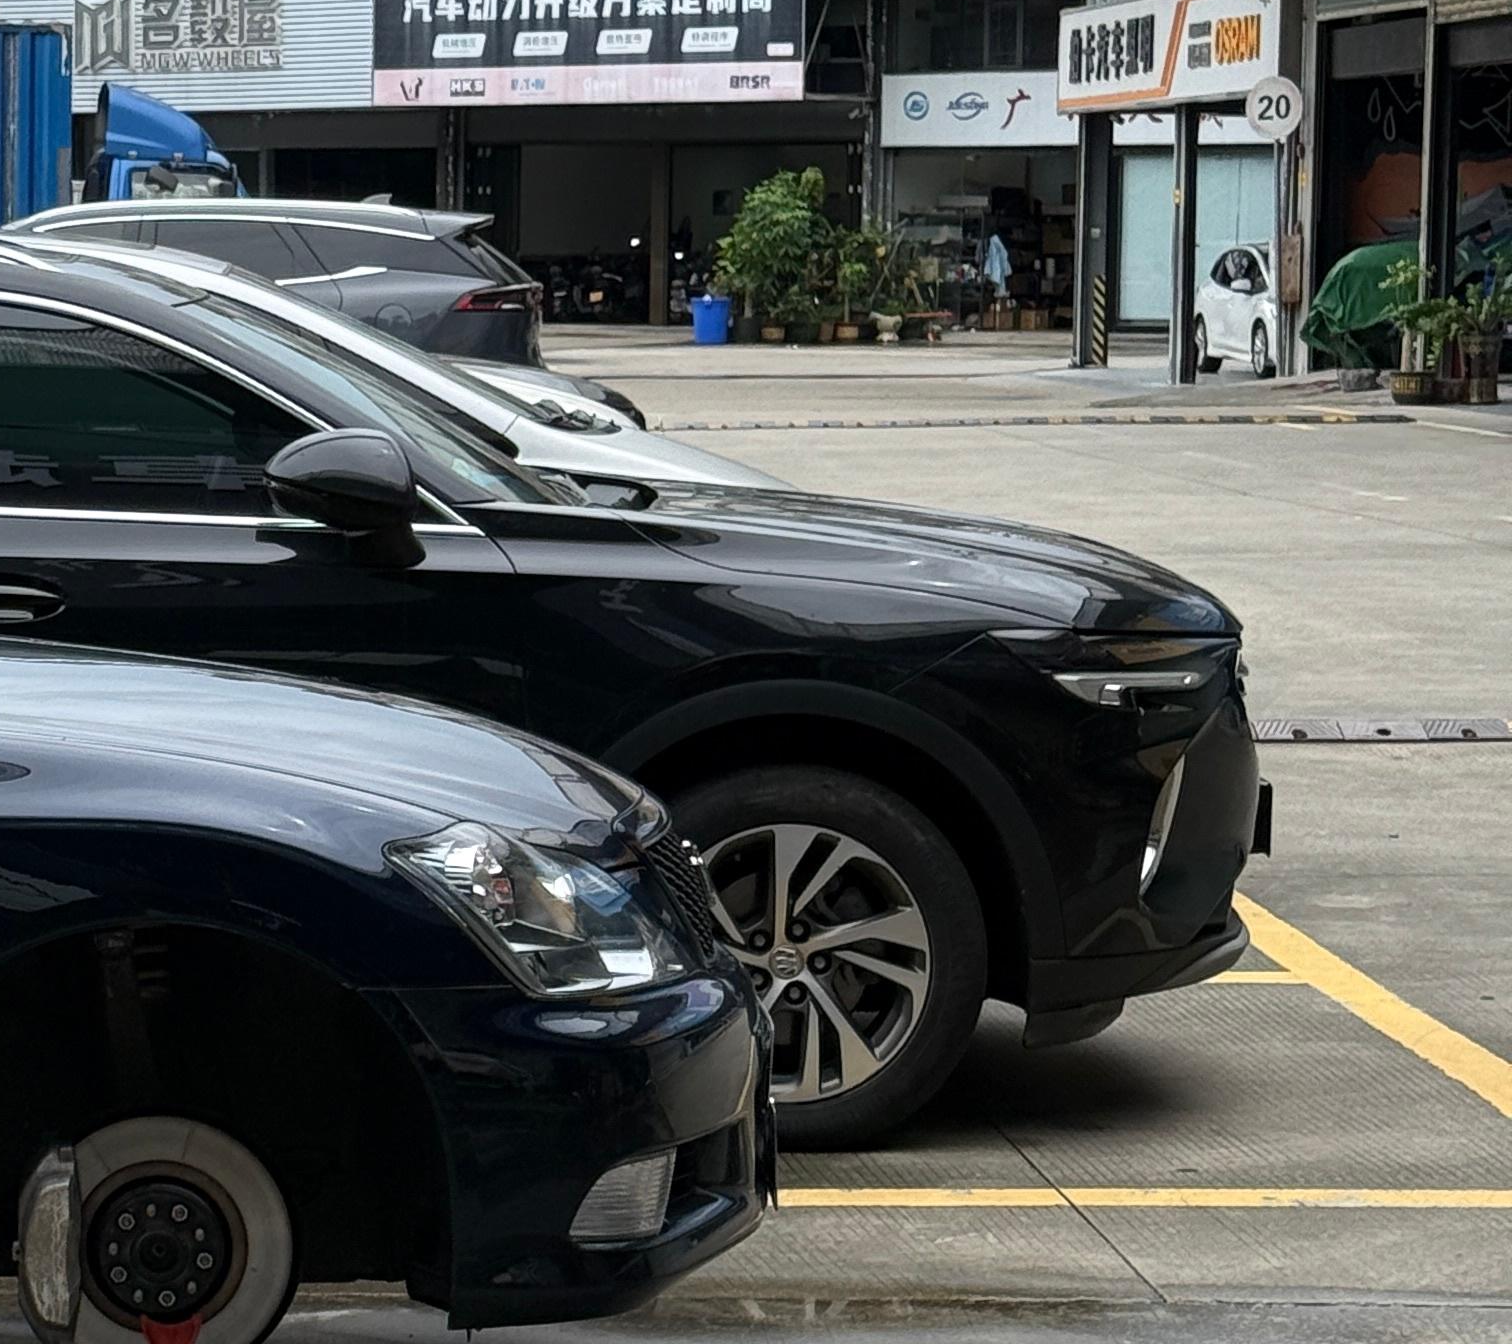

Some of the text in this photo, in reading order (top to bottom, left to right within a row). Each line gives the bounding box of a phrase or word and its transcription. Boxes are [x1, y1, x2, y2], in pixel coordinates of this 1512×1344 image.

[1215, 14, 1261, 66] OSRAM
[196, 49, 281, 69] WHEELS
[451, 80, 485, 94] HKS
[1257, 94, 1291, 121] 20
